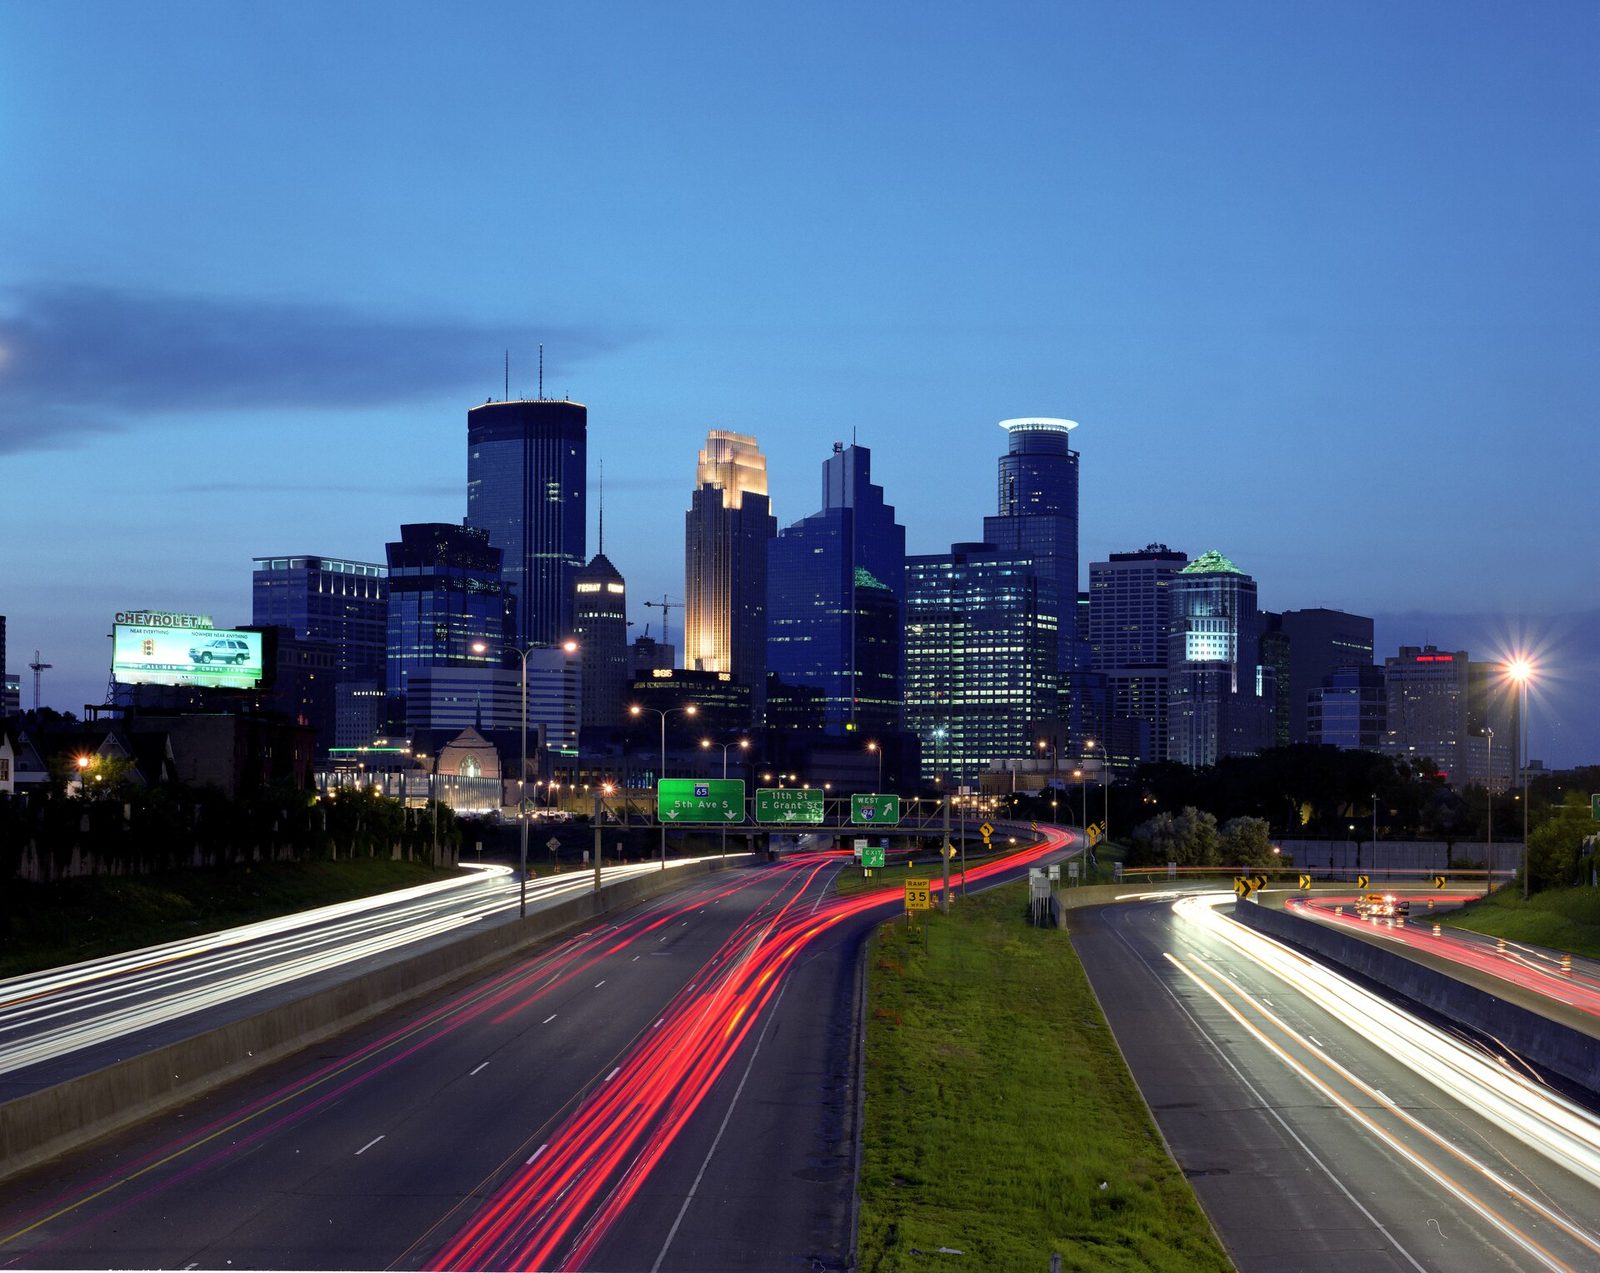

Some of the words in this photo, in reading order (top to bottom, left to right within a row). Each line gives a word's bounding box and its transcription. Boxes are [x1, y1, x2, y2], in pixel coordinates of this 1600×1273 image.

[115, 612, 198, 627] CHEVROLET
[696, 788, 707, 796] 65
[772, 792, 792, 800] 11th
[796, 792, 808, 800] St
[674, 800, 693, 809] 5th
[698, 800, 717, 809] Ave
[722, 800, 729, 809] S
[761, 801, 768, 809] E
[773, 801, 802, 809] Grant
[807, 802, 818, 810] St
[863, 809, 873, 818] 94
[908, 892, 926, 901] 35
